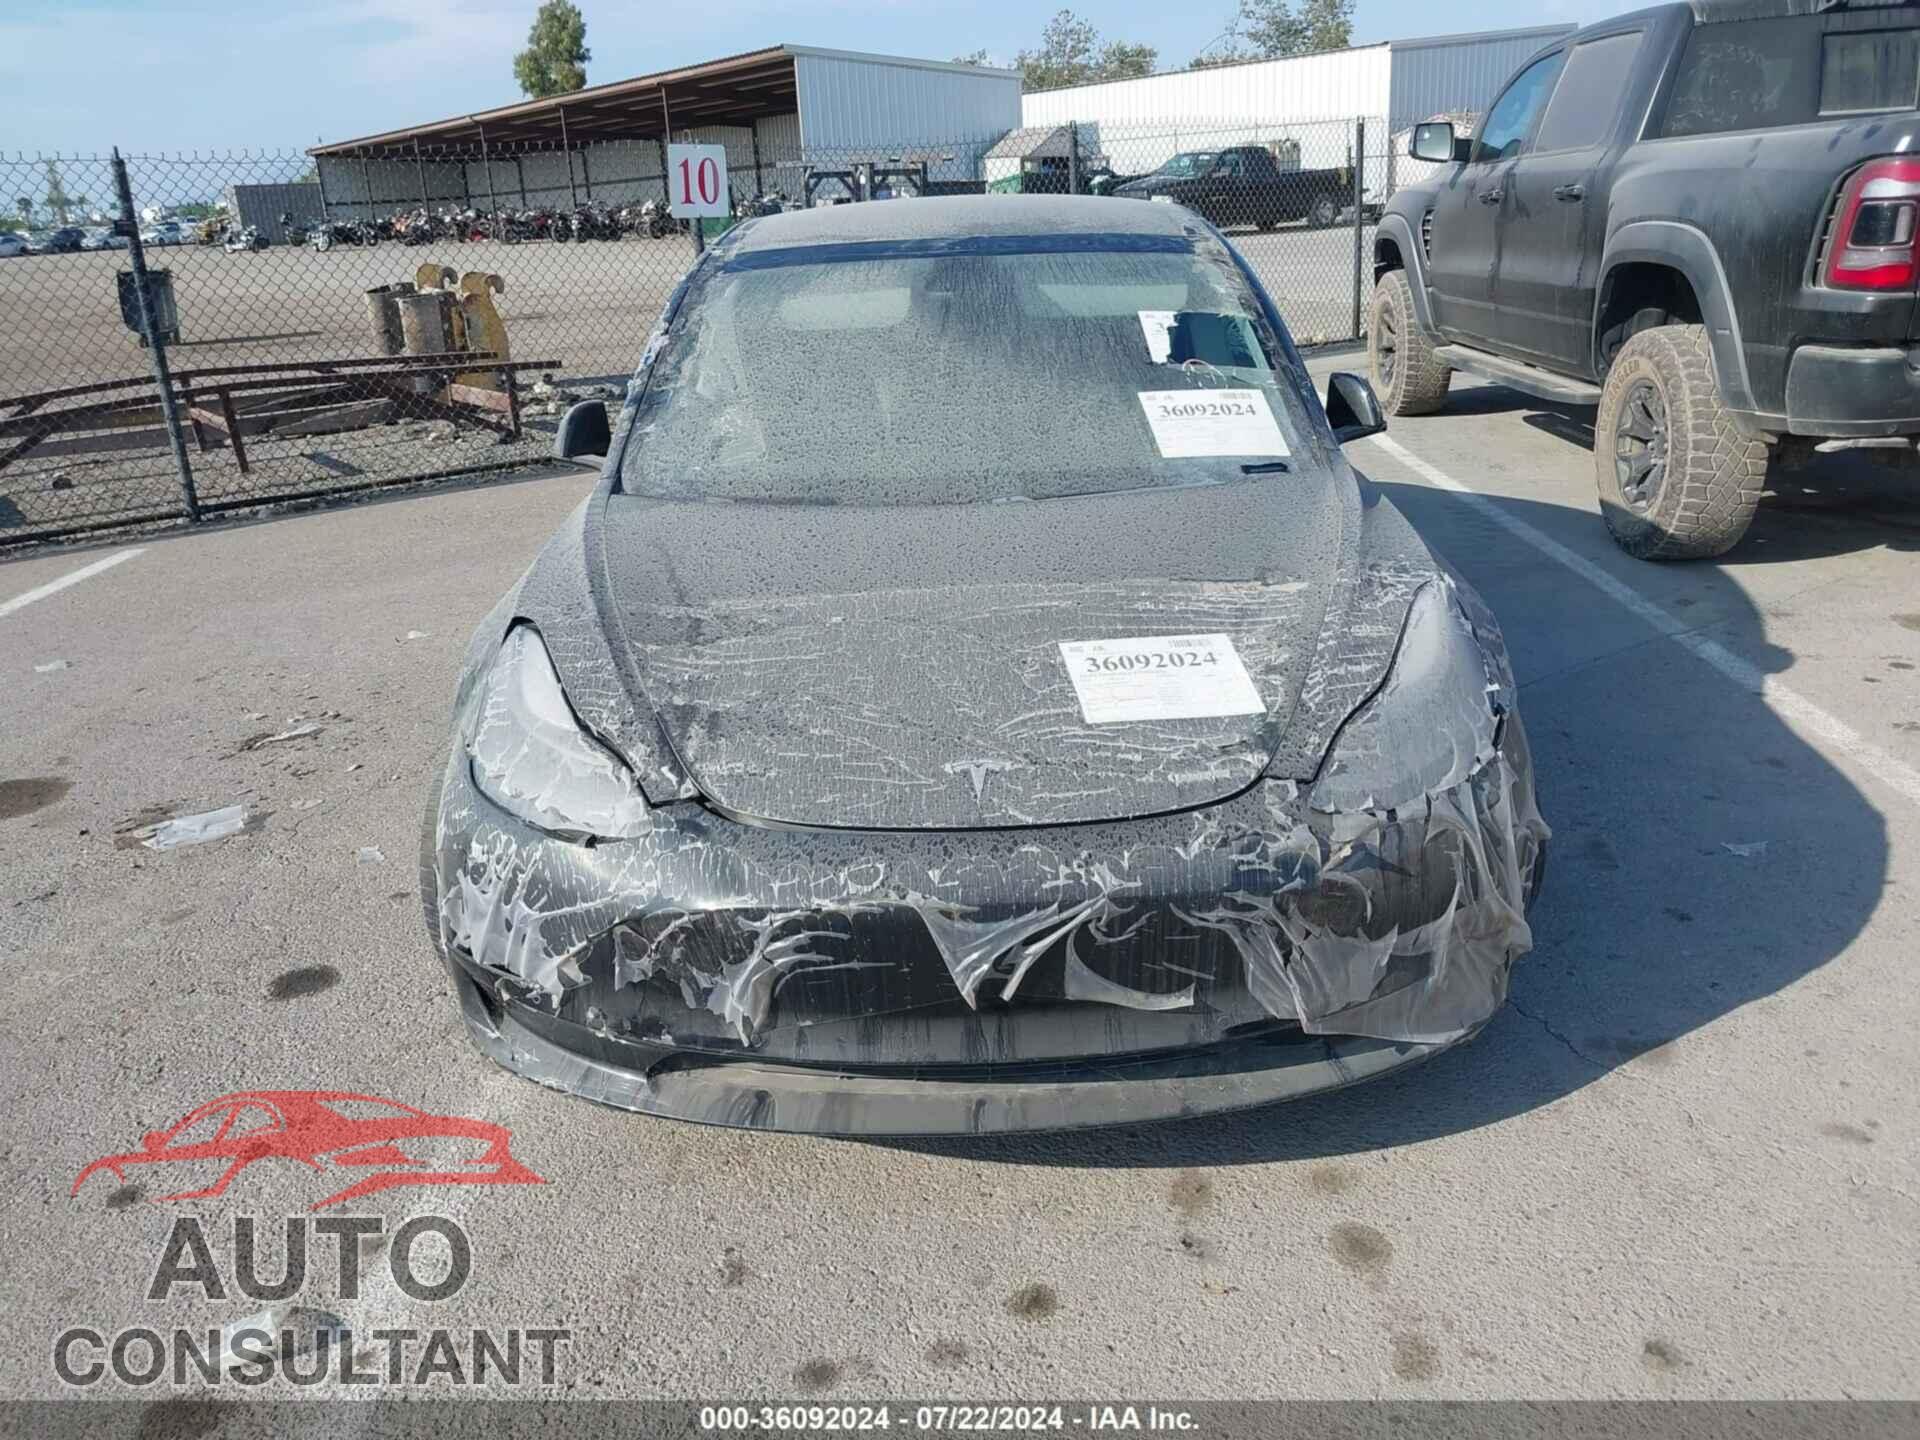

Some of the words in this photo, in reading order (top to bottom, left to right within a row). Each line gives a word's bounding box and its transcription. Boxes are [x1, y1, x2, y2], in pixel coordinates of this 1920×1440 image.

[678, 157, 720, 205] 10
[1159, 403, 1256, 418] 36092024
[1085, 651, 1219, 673] 36092024
